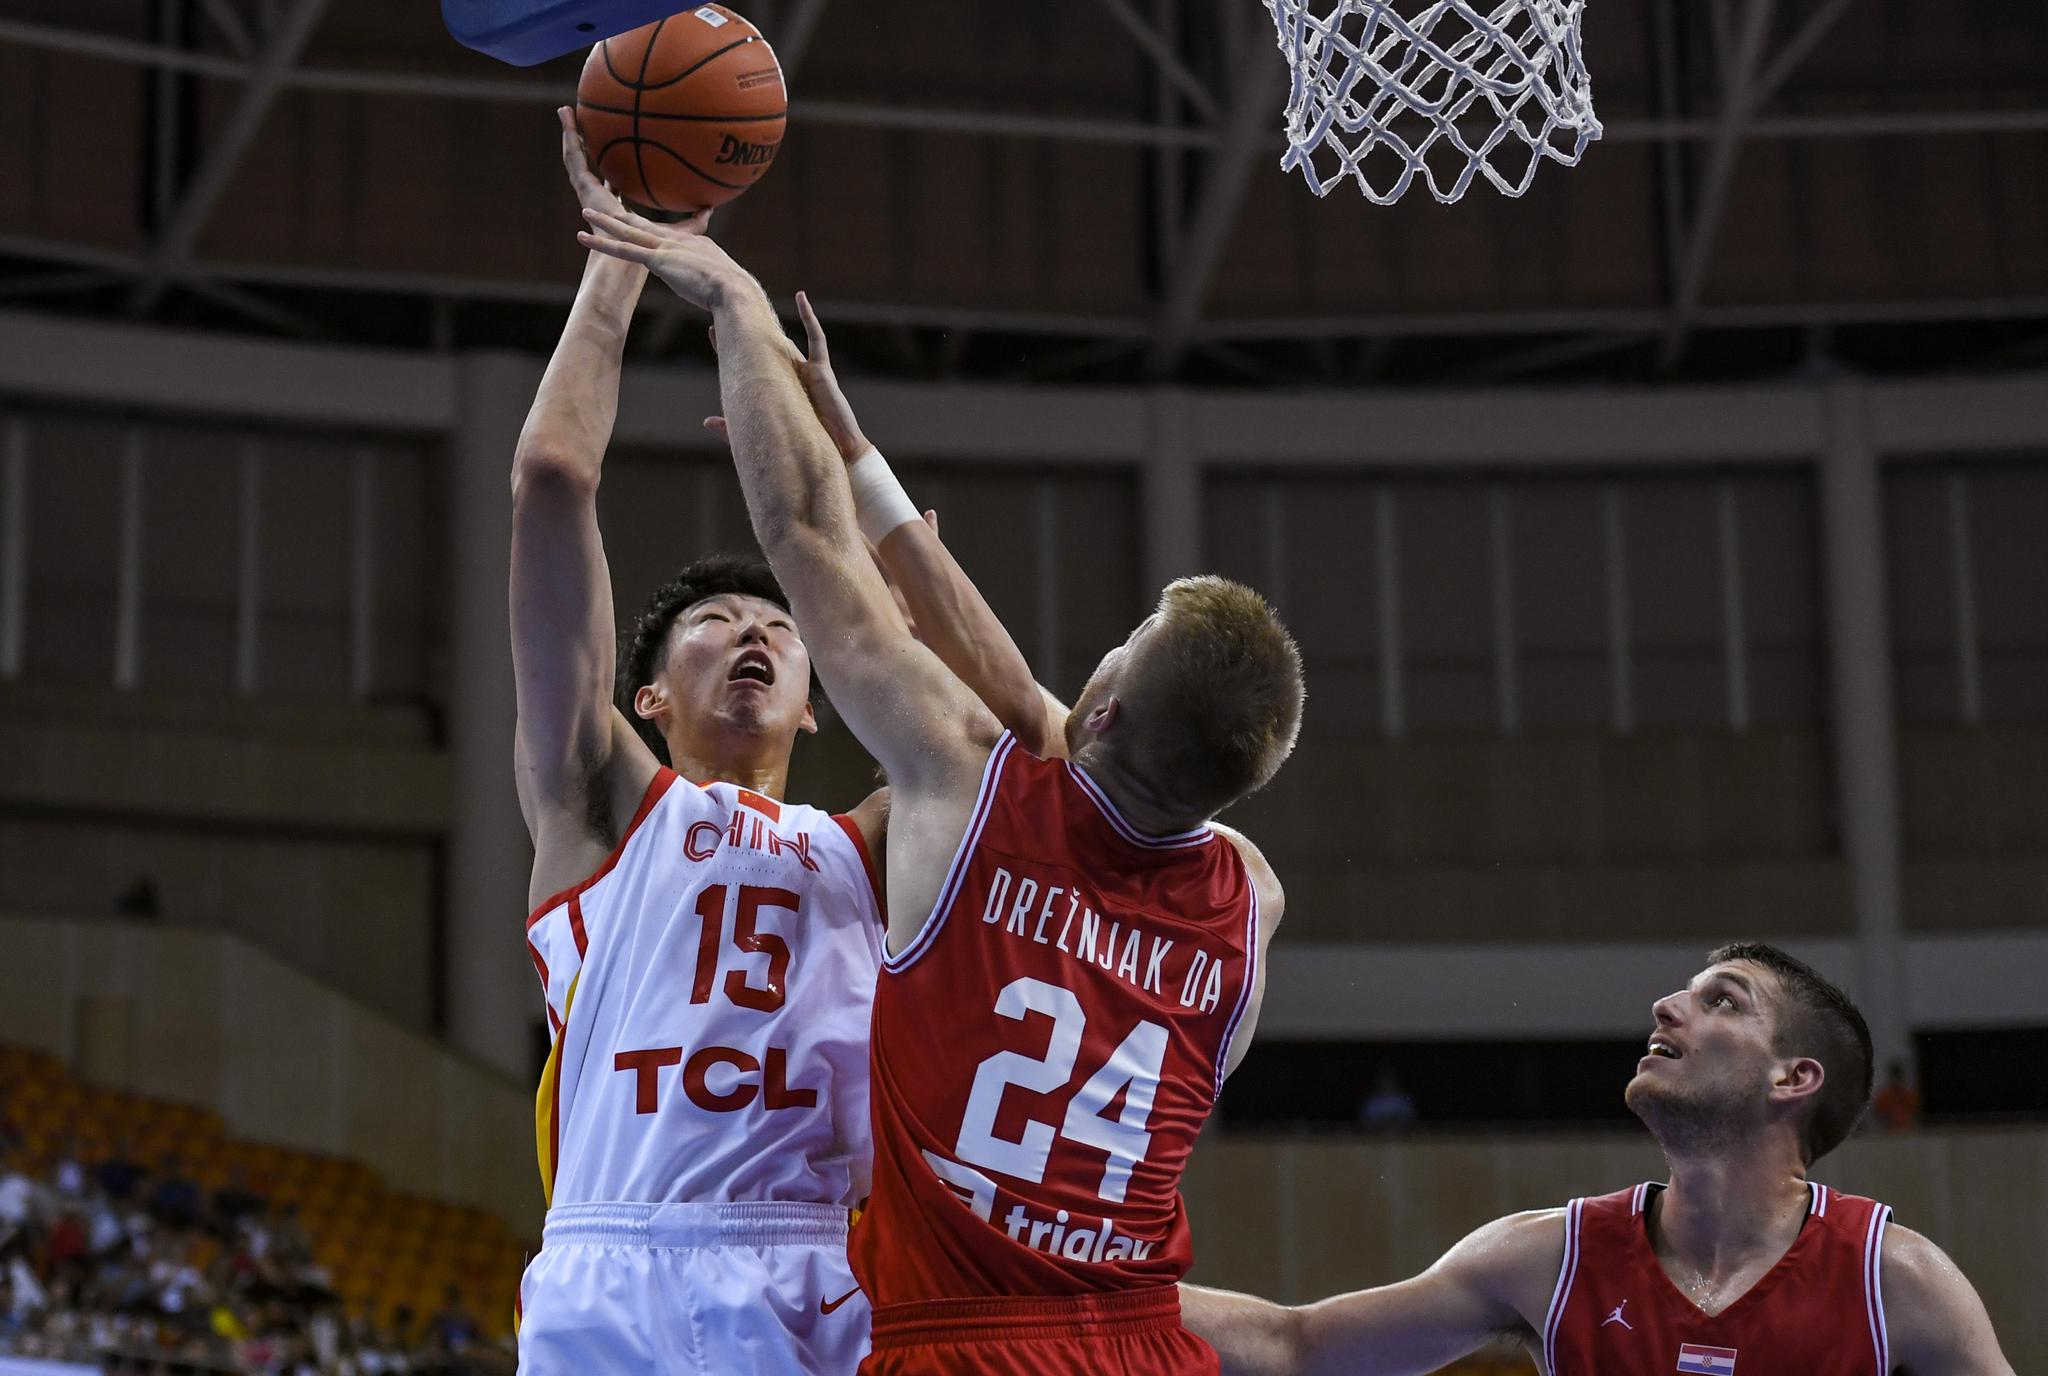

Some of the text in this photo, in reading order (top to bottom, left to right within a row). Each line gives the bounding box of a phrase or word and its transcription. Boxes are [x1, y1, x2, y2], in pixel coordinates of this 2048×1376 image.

[689, 883, 802, 1015] 15
[982, 866, 1224, 1015] DREŽNJAK DA
[614, 1046, 819, 1115] TCL
[954, 976, 1170, 1205] 24
